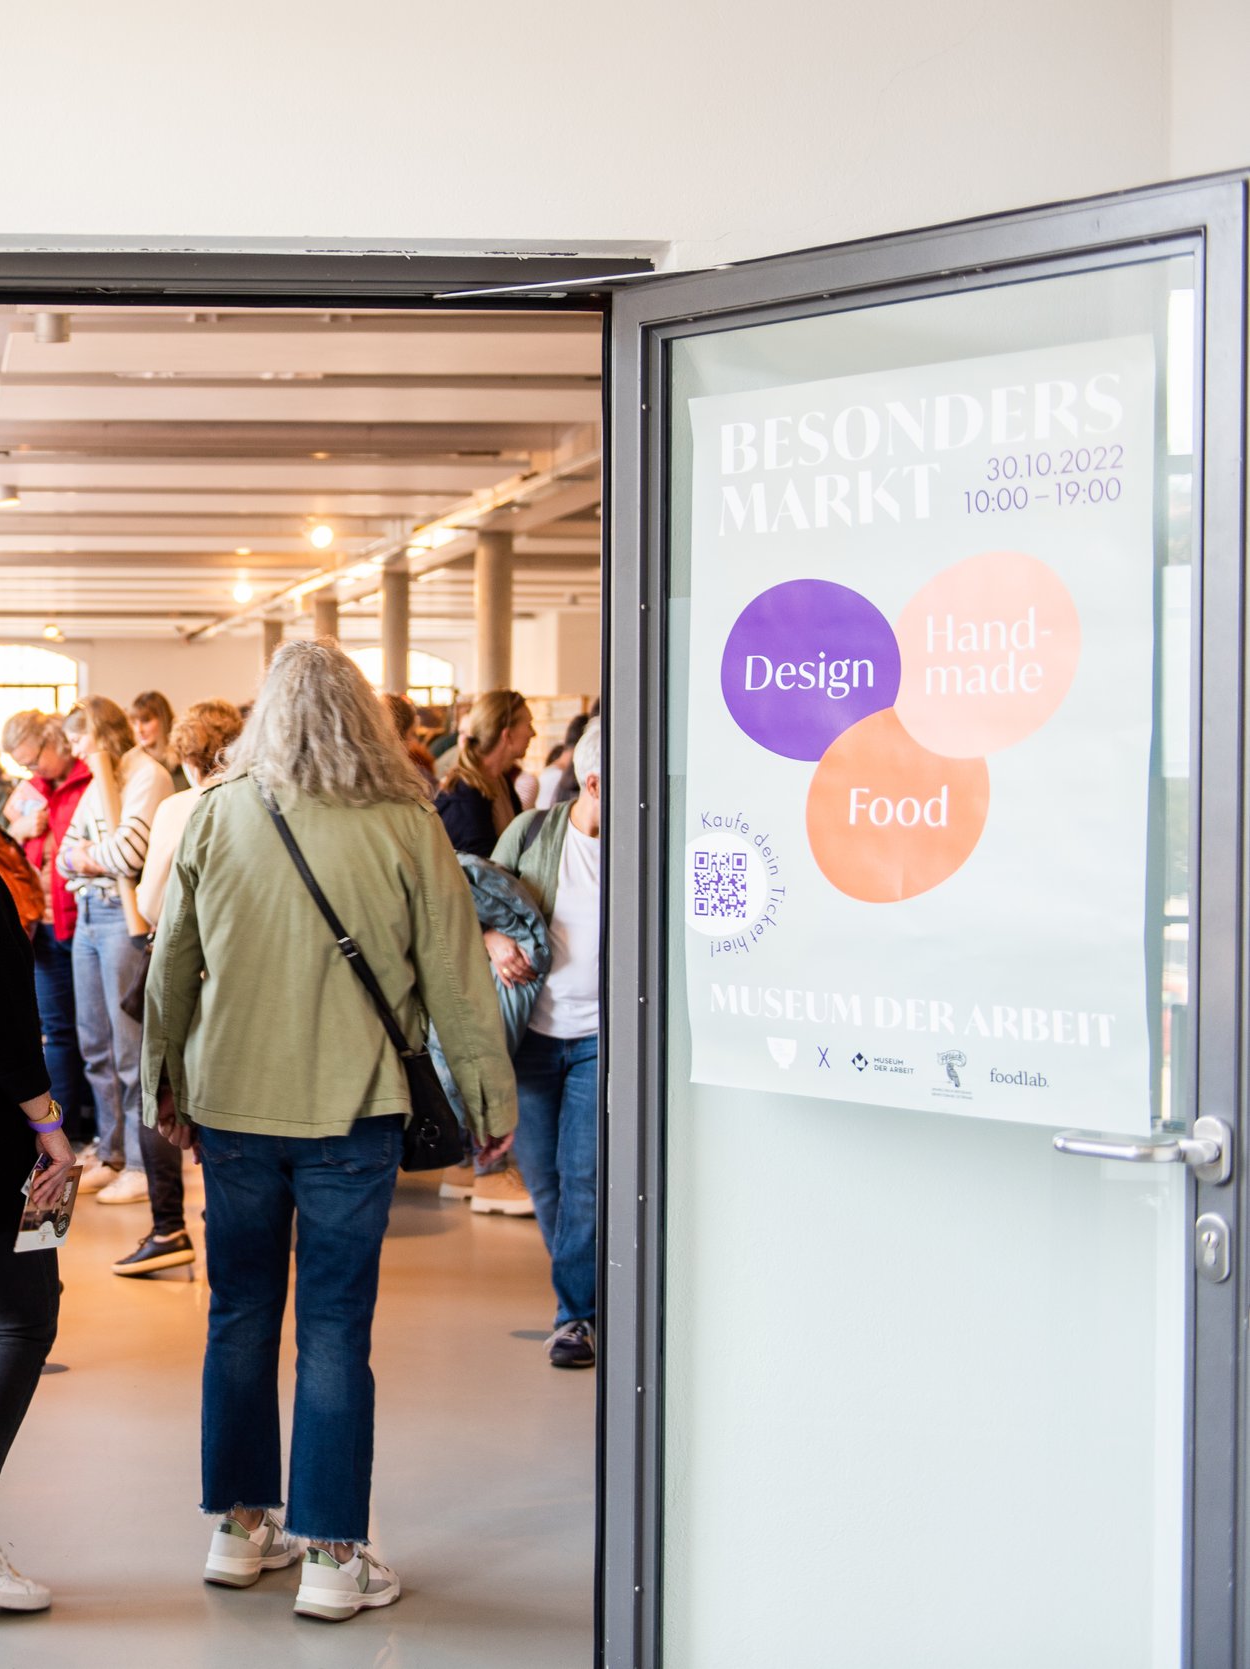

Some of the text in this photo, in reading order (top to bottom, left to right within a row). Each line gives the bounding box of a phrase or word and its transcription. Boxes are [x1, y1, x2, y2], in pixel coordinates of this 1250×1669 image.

[721, 373, 1125, 475] BESONDERS
[986, 444, 1125, 482] 30.10.2022
[718, 462, 941, 537] MARKT
[963, 486, 1029, 515] 10:00
[1054, 476, 1122, 506] 19:00
[925, 606, 1052, 654] Hand-
[745, 651, 875, 699] Design
[925, 652, 1044, 696] made
[849, 784, 949, 828] Food
[701, 811, 787, 958] Kaufe dein Ticket hier!
[710, 982, 1116, 1048] MUSEUM DER ARBEIT
[873, 1057, 904, 1066] MUSEUM
[889, 1067, 915, 1075] ARBEIT
[989, 1068, 1050, 1088] foodlab.
